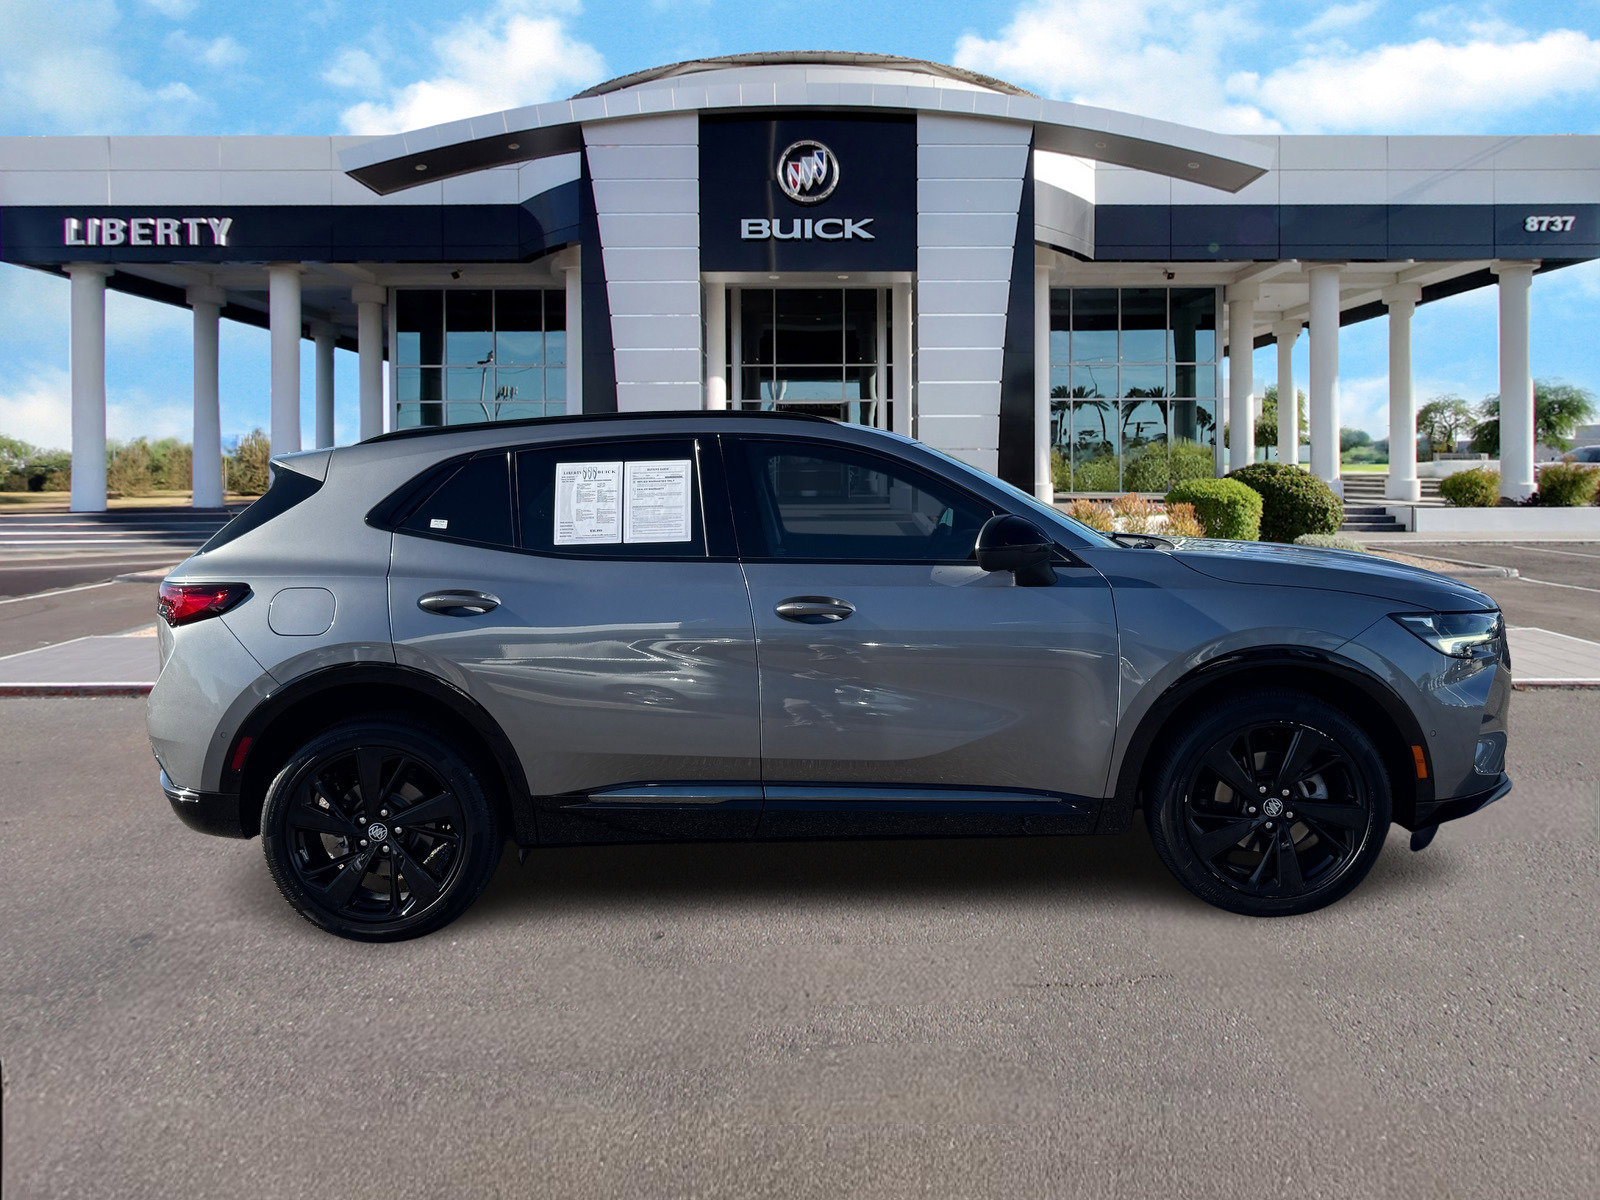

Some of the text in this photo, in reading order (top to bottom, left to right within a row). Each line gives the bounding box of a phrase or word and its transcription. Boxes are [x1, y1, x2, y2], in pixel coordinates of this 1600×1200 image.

[64, 217, 233, 246] LIBERTY
[741, 218, 875, 239] BUICK
[1524, 215, 1576, 232] 8737
